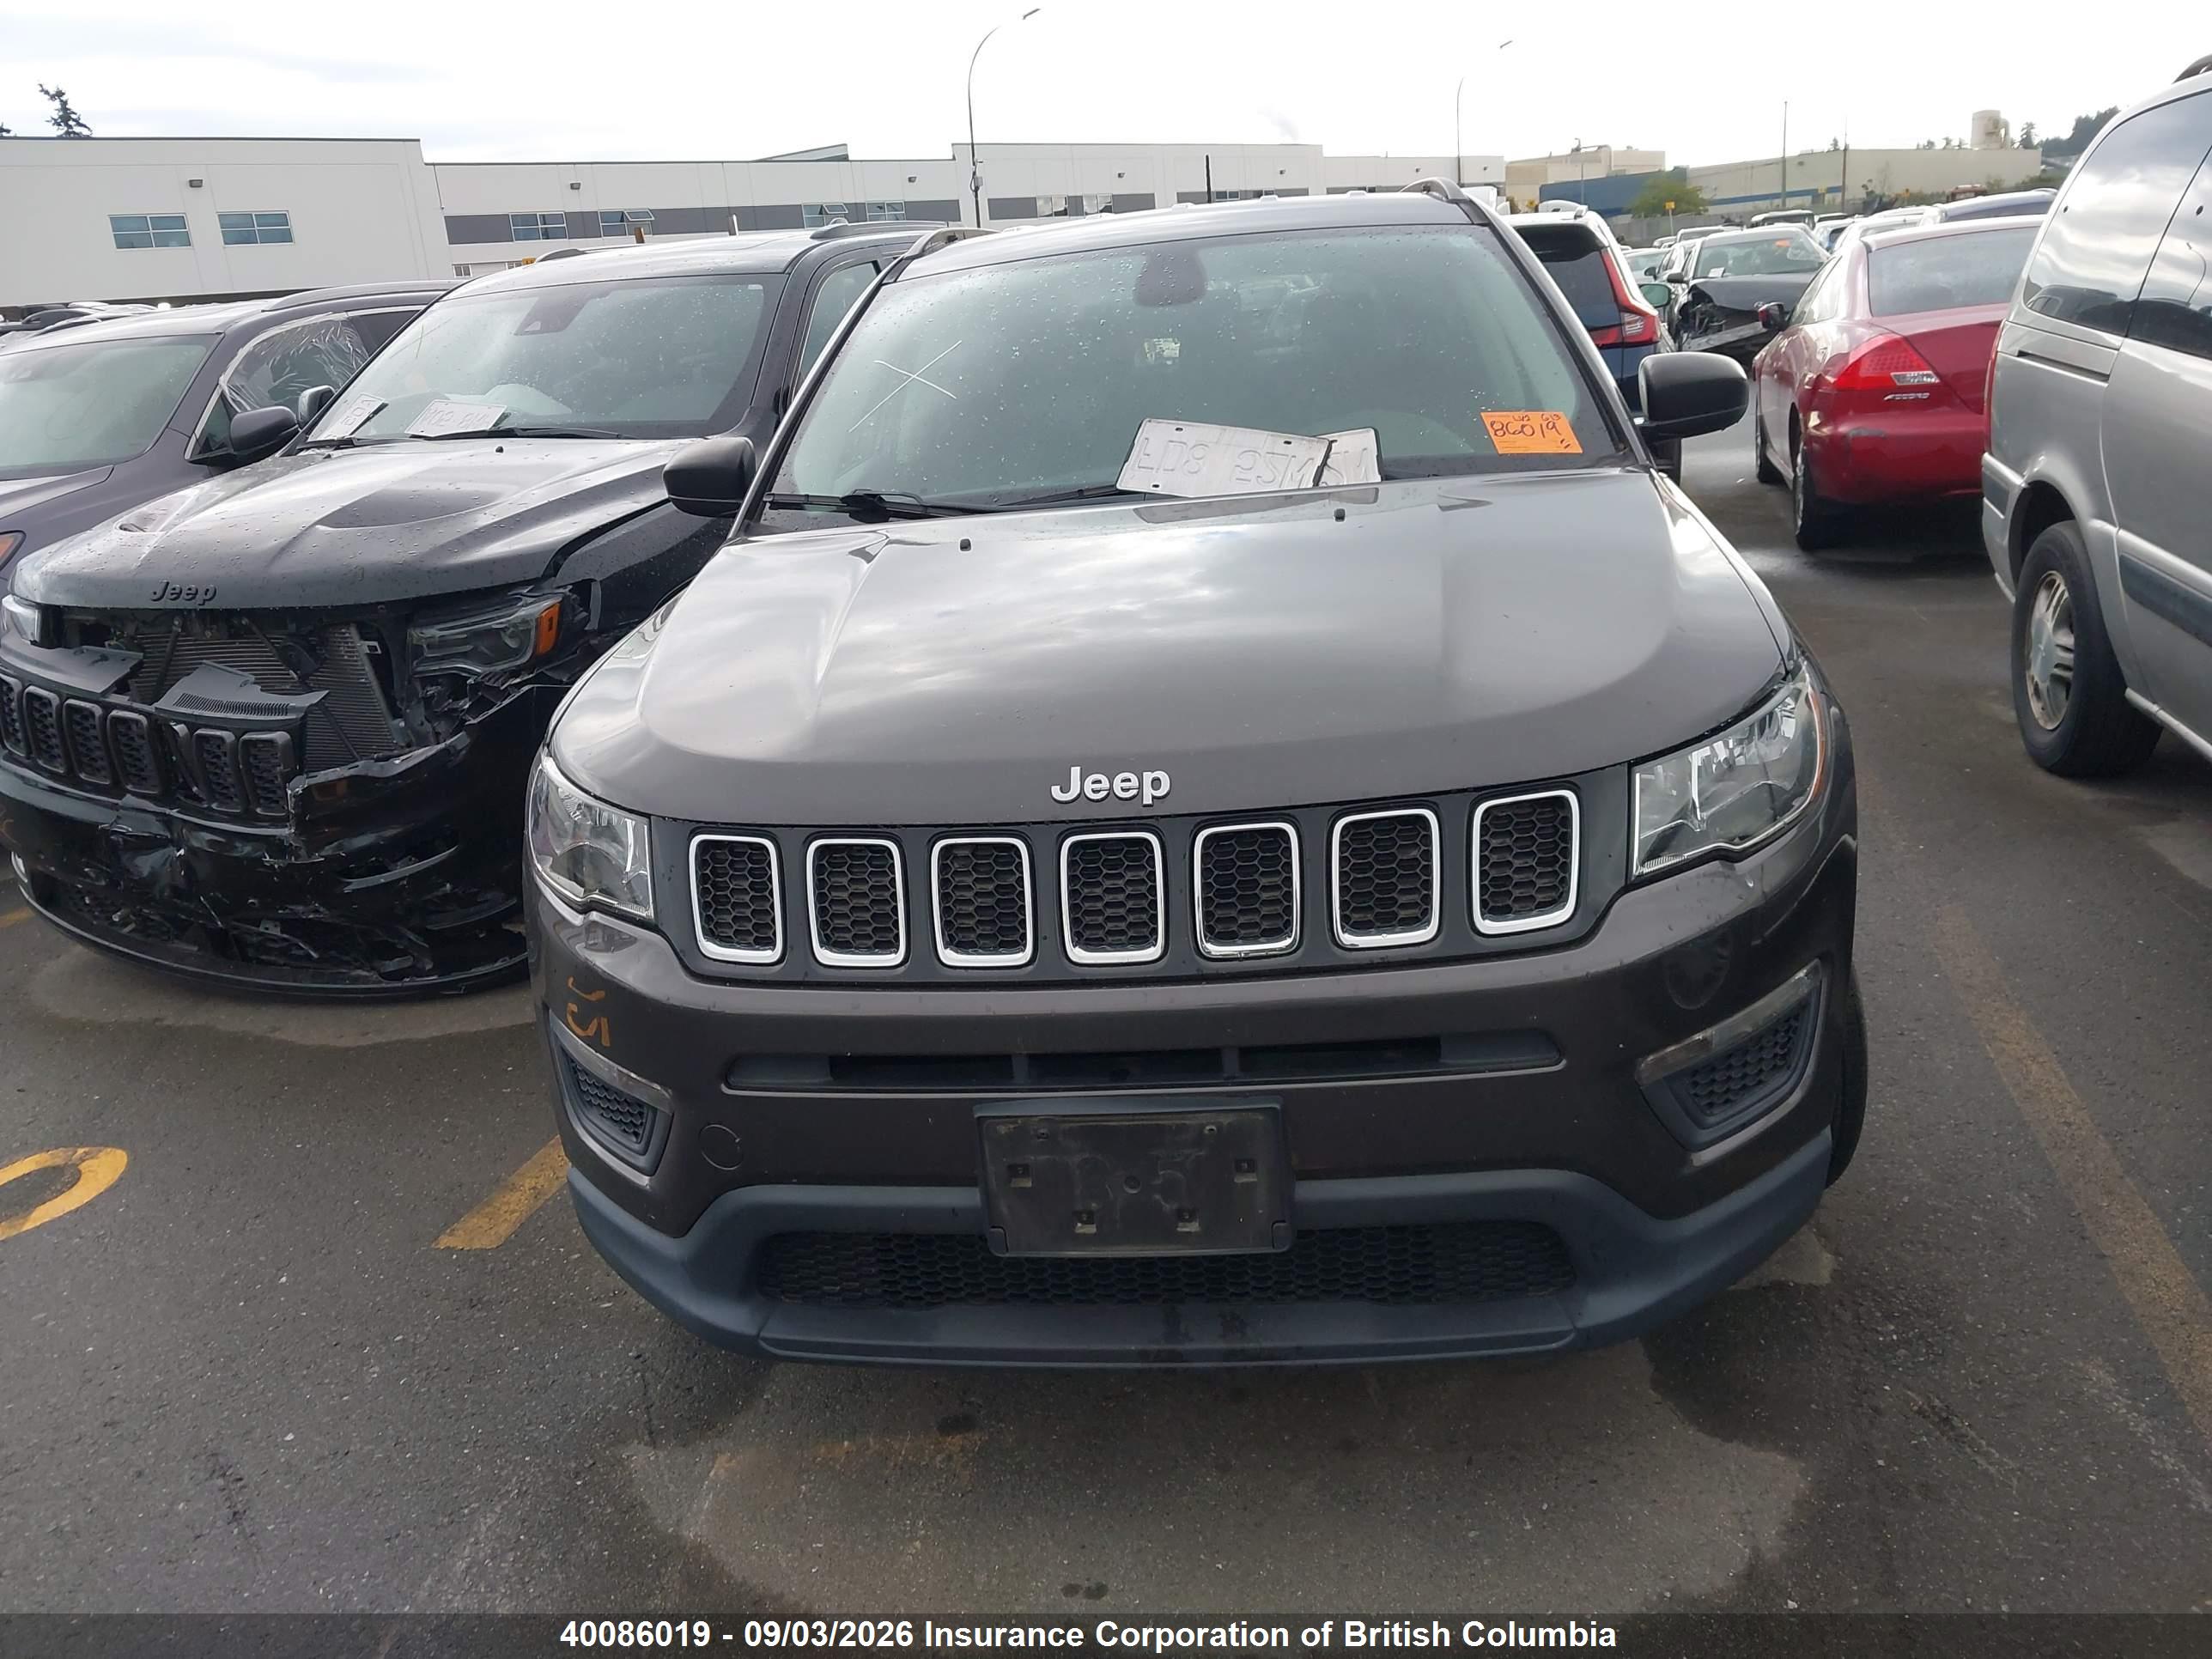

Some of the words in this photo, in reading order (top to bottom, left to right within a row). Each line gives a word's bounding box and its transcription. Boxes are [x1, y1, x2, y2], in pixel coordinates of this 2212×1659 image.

[1490, 420, 1562, 439] 86019
[150, 580, 217, 606] Jeep
[1050, 765, 1171, 807] Jeep
